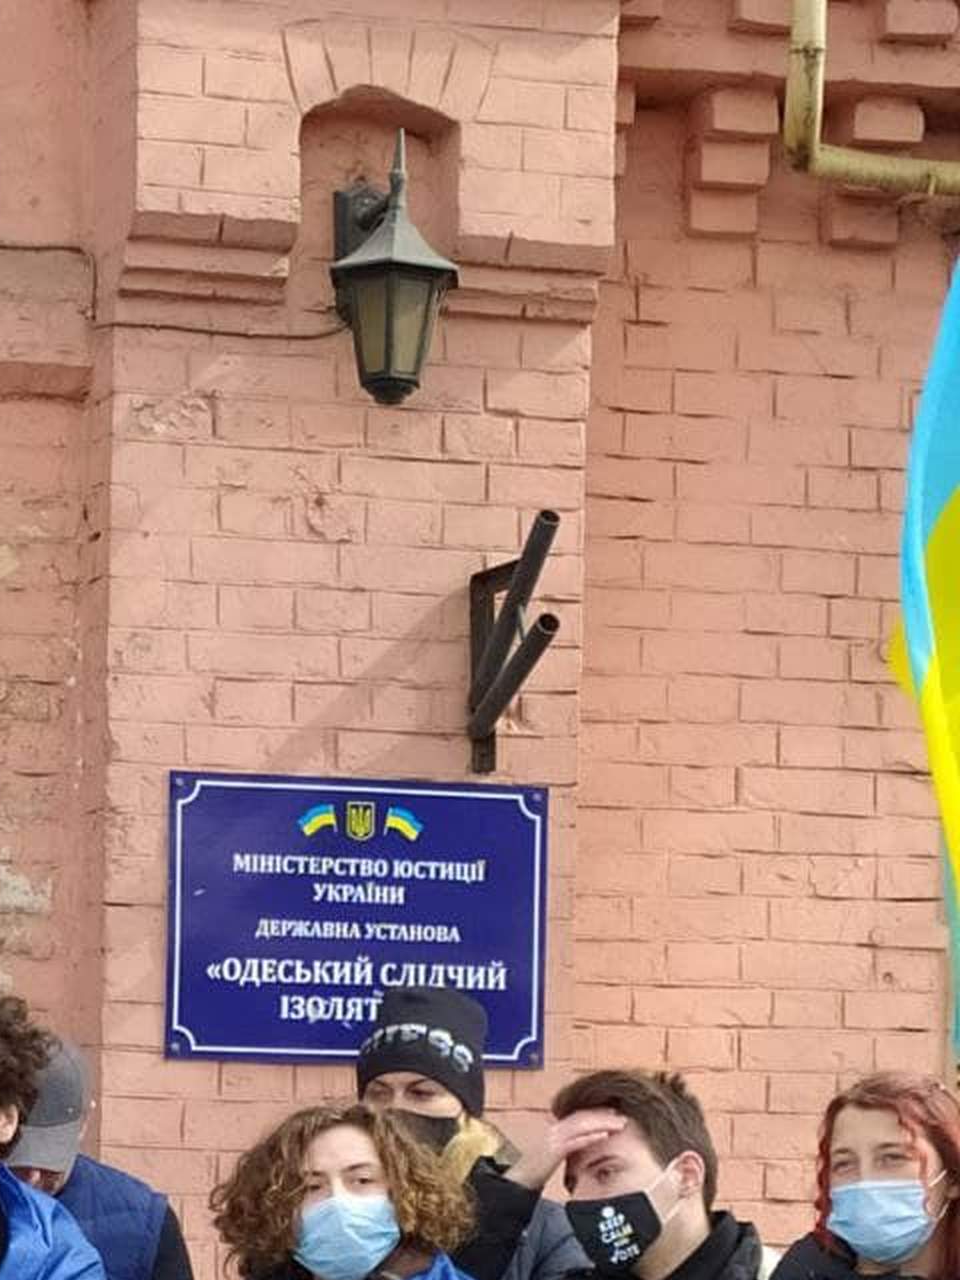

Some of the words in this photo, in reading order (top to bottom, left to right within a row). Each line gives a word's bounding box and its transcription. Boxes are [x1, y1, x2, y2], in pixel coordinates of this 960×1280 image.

[232, 853, 389, 878] МІНІСТЕРСТВО
[392, 860, 486, 883] ЮСТИЦІЇ
[313, 882, 405, 905] УКРАЇНИ
[254, 918, 361, 939] ДЕРЖАВНА
[364, 922, 461, 943] УСТАНОВА
[206, 955, 374, 988] «ОДЕСЬКИЙ
[380, 960, 507, 991] СЛІДЧИЙ
